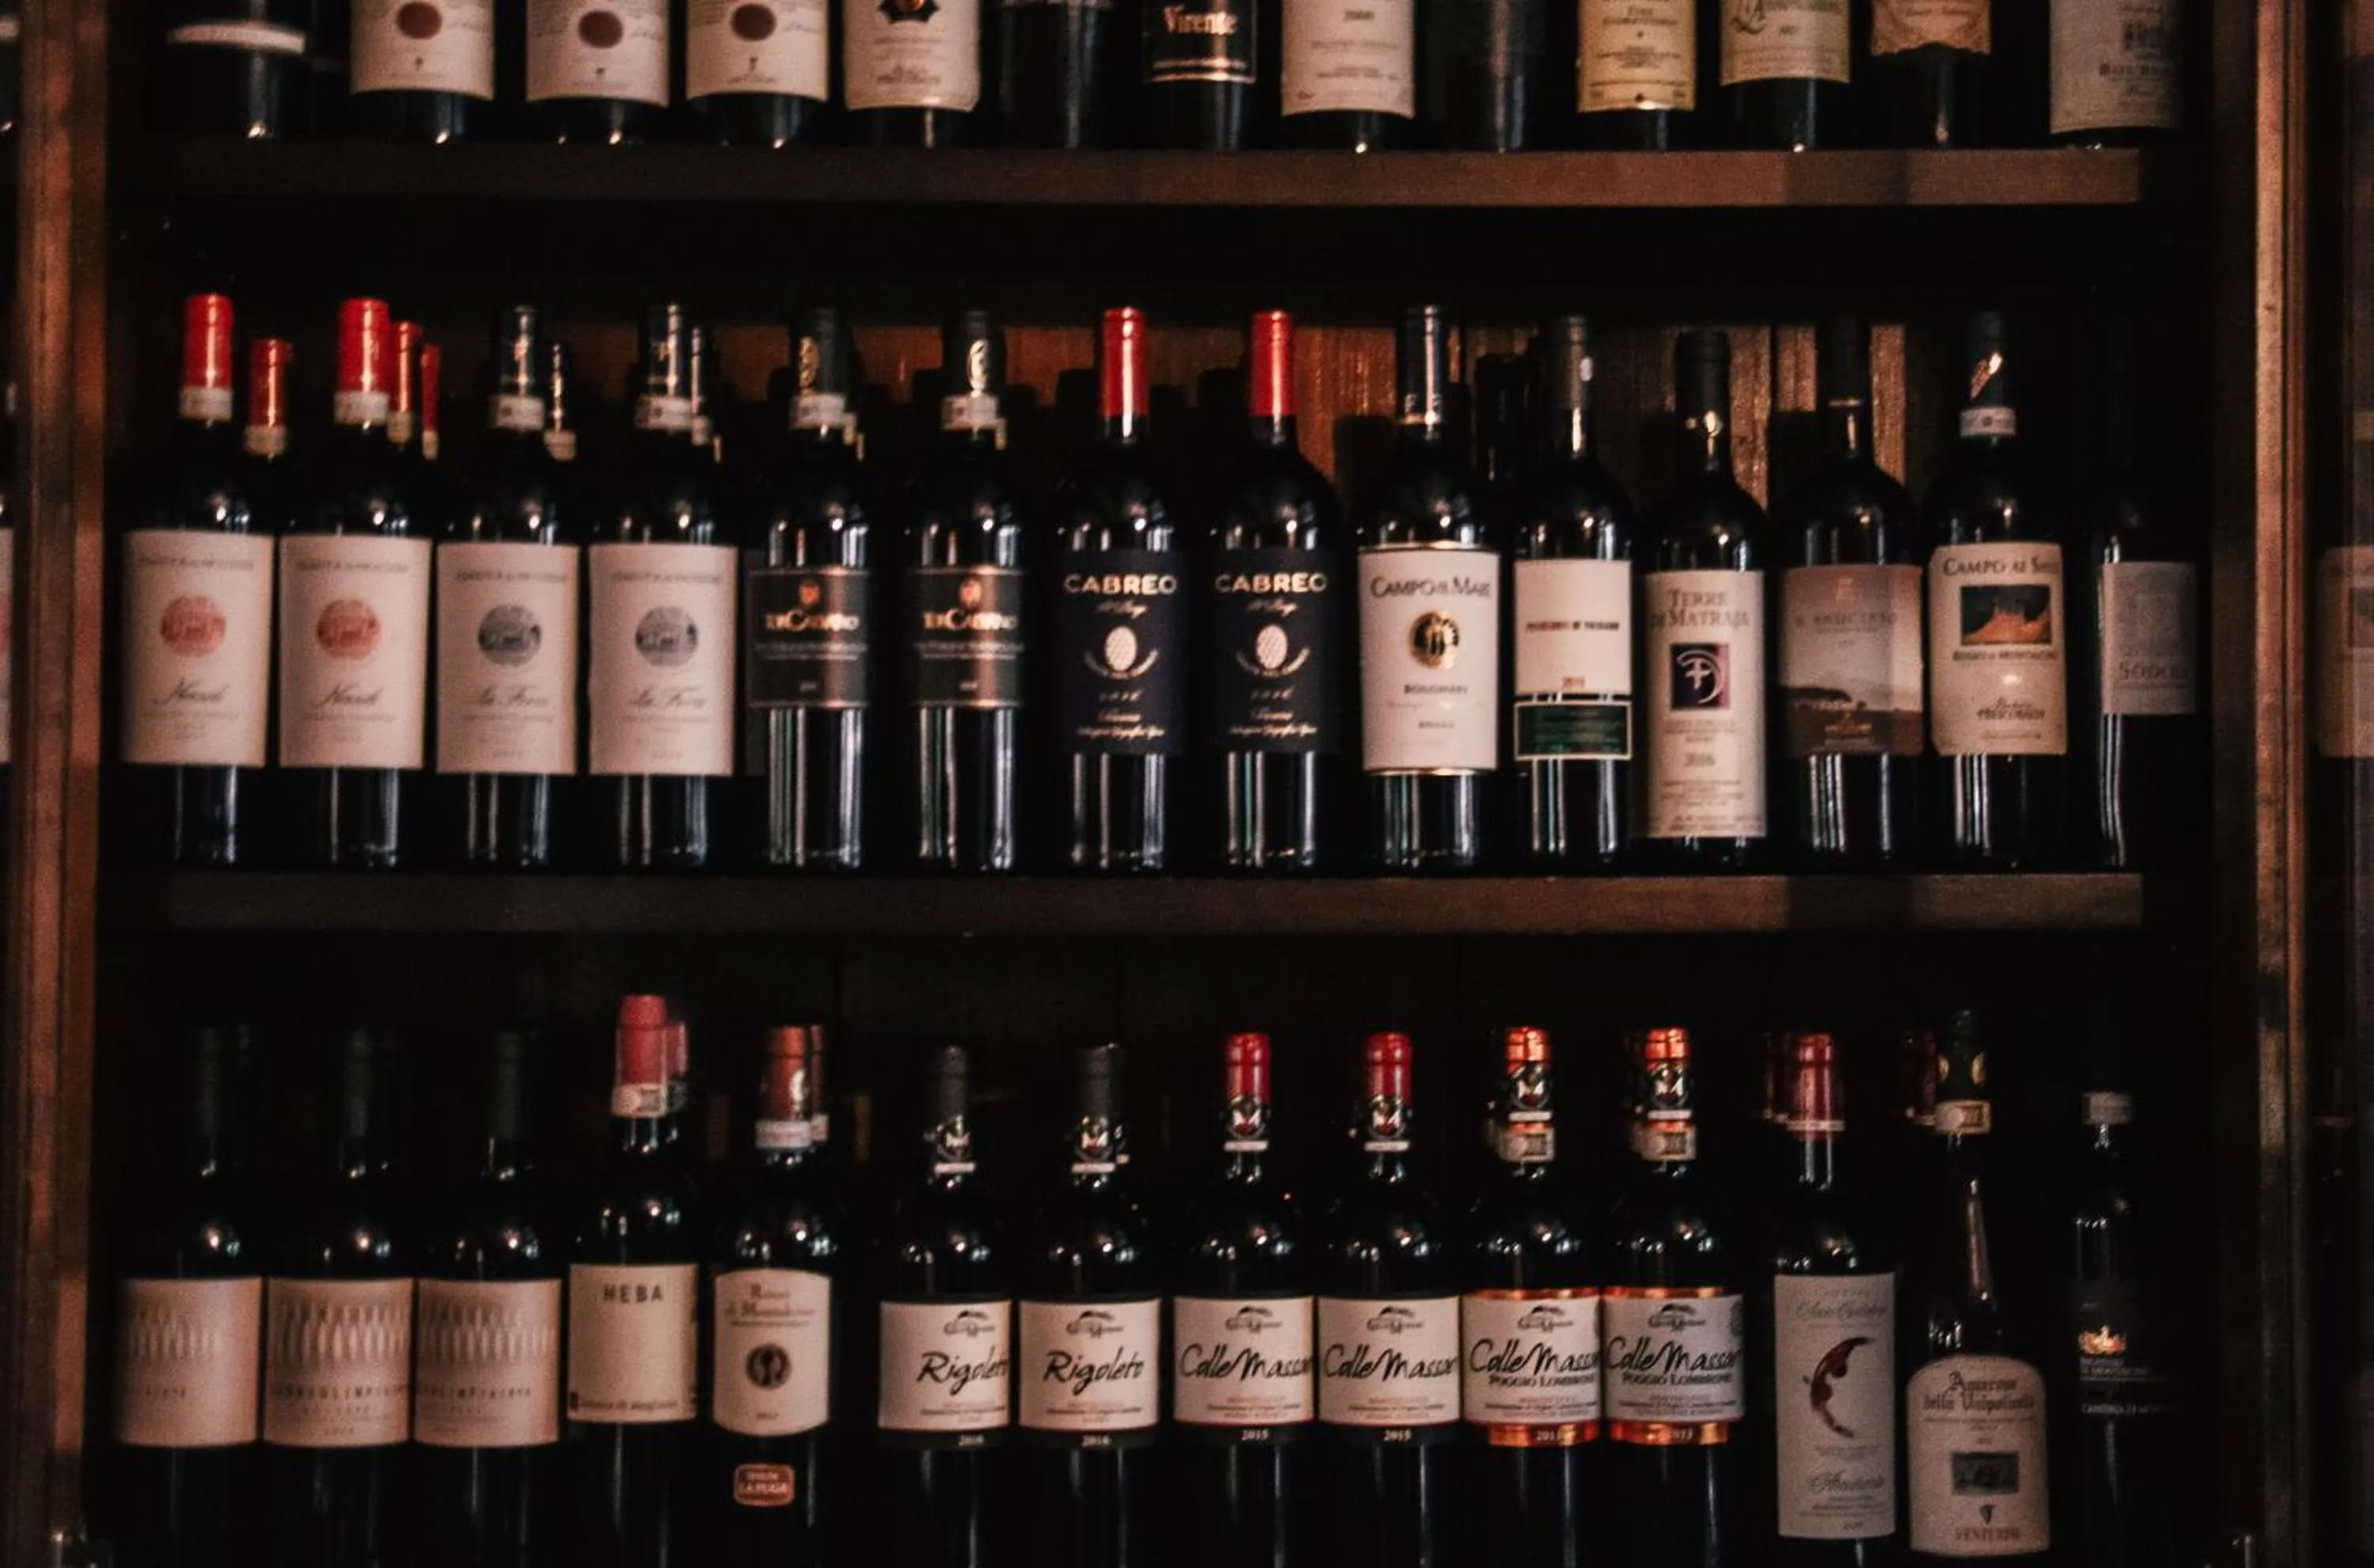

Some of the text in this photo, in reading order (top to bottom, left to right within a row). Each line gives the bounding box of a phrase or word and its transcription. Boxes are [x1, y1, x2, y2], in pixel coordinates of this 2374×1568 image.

[1944, 557, 2006, 576] CAMPO
[1064, 574, 1178, 594] CABREO
[1215, 572, 1328, 593] CABREO
[1371, 576, 1435, 597] CAMPO
[603, 1284, 665, 1303] HEBA
